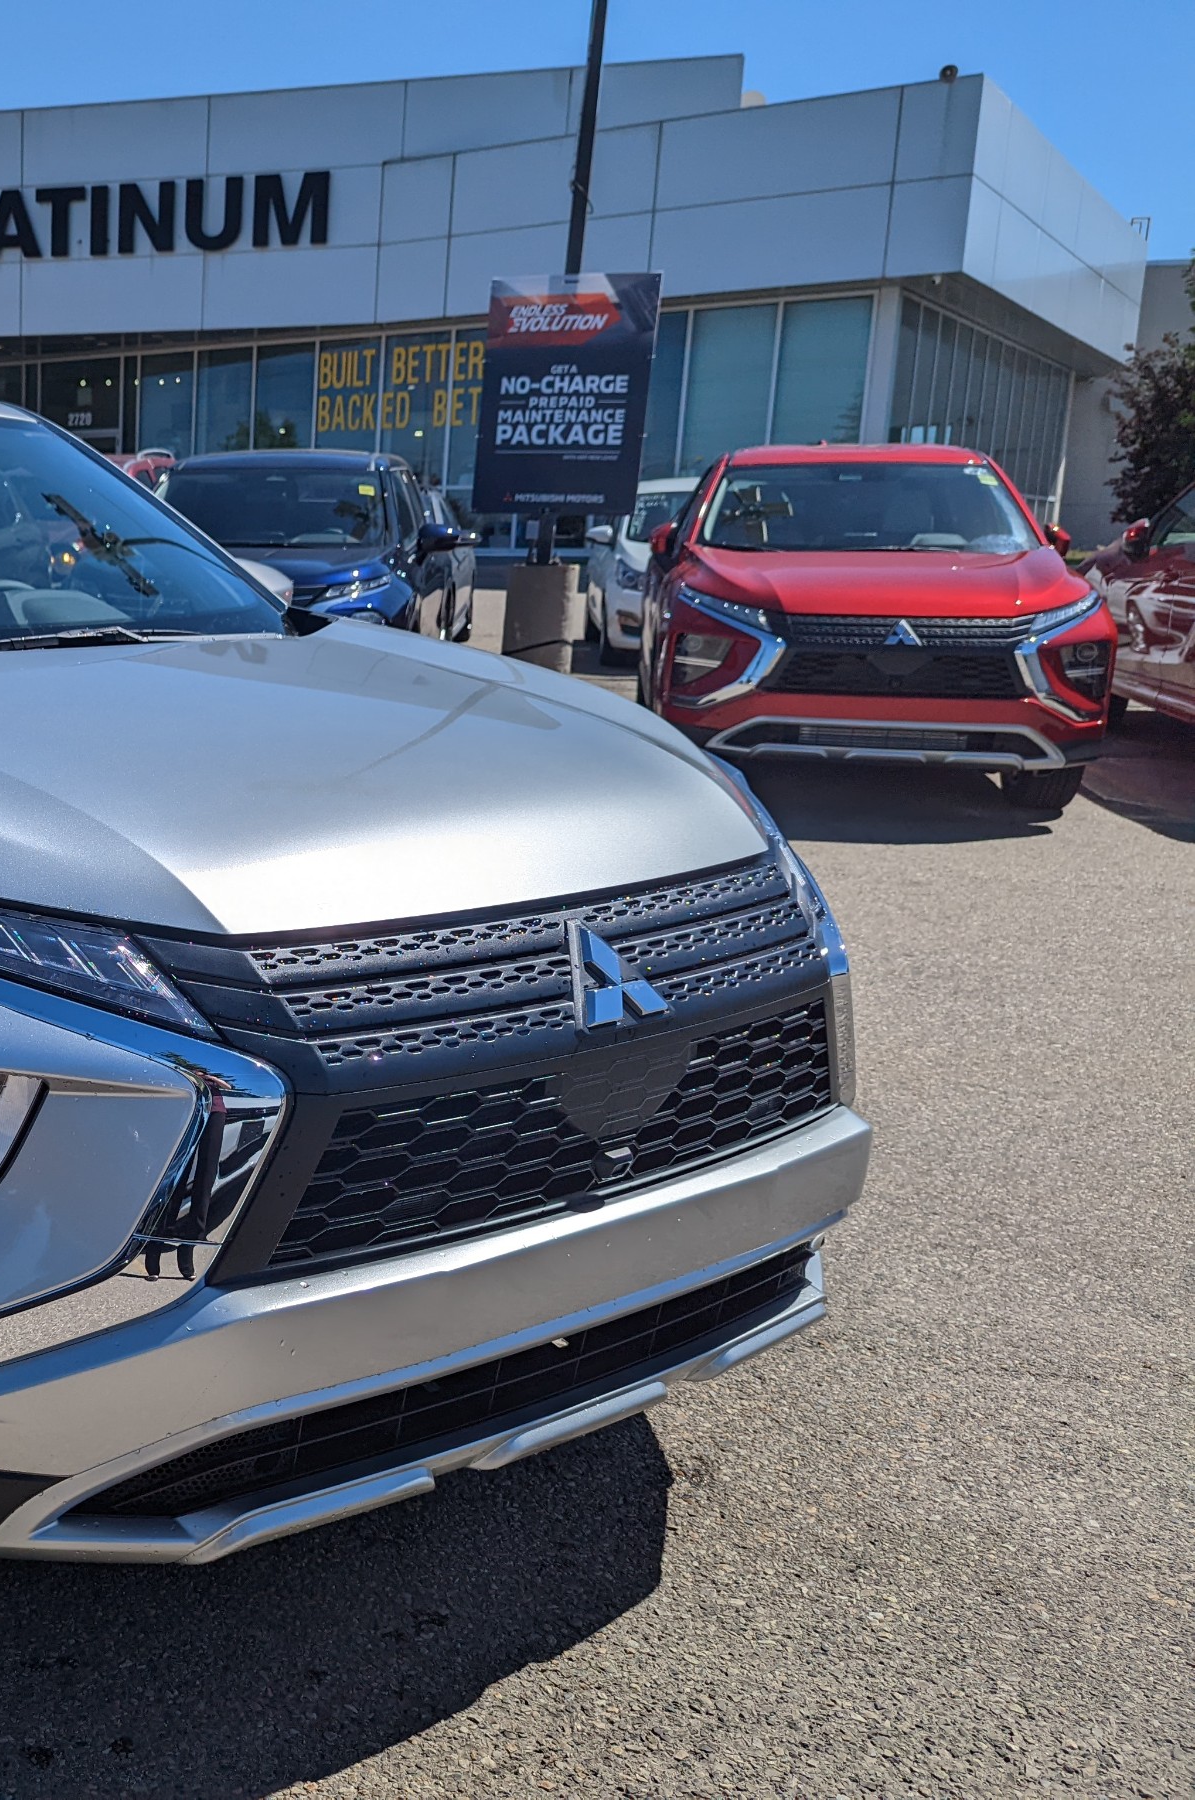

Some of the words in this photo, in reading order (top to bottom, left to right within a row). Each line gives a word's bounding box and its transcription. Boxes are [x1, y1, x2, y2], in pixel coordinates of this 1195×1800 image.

[510, 303, 568, 318] ENDLESS
[508, 314, 609, 333] EVOLUTION
[319, 349, 375, 389] BUILT
[392, 341, 484, 384] BETTER
[551, 364, 570, 374] GET
[569, 364, 578, 373] A
[500, 375, 630, 394] NO-CHARGE
[528, 396, 595, 408] PREPAID
[317, 391, 410, 432] BACKED
[497, 409, 626, 423] MAINTENANCE
[495, 424, 624, 445] PACKAGE
[514, 493, 565, 503] MITSUBISHI
